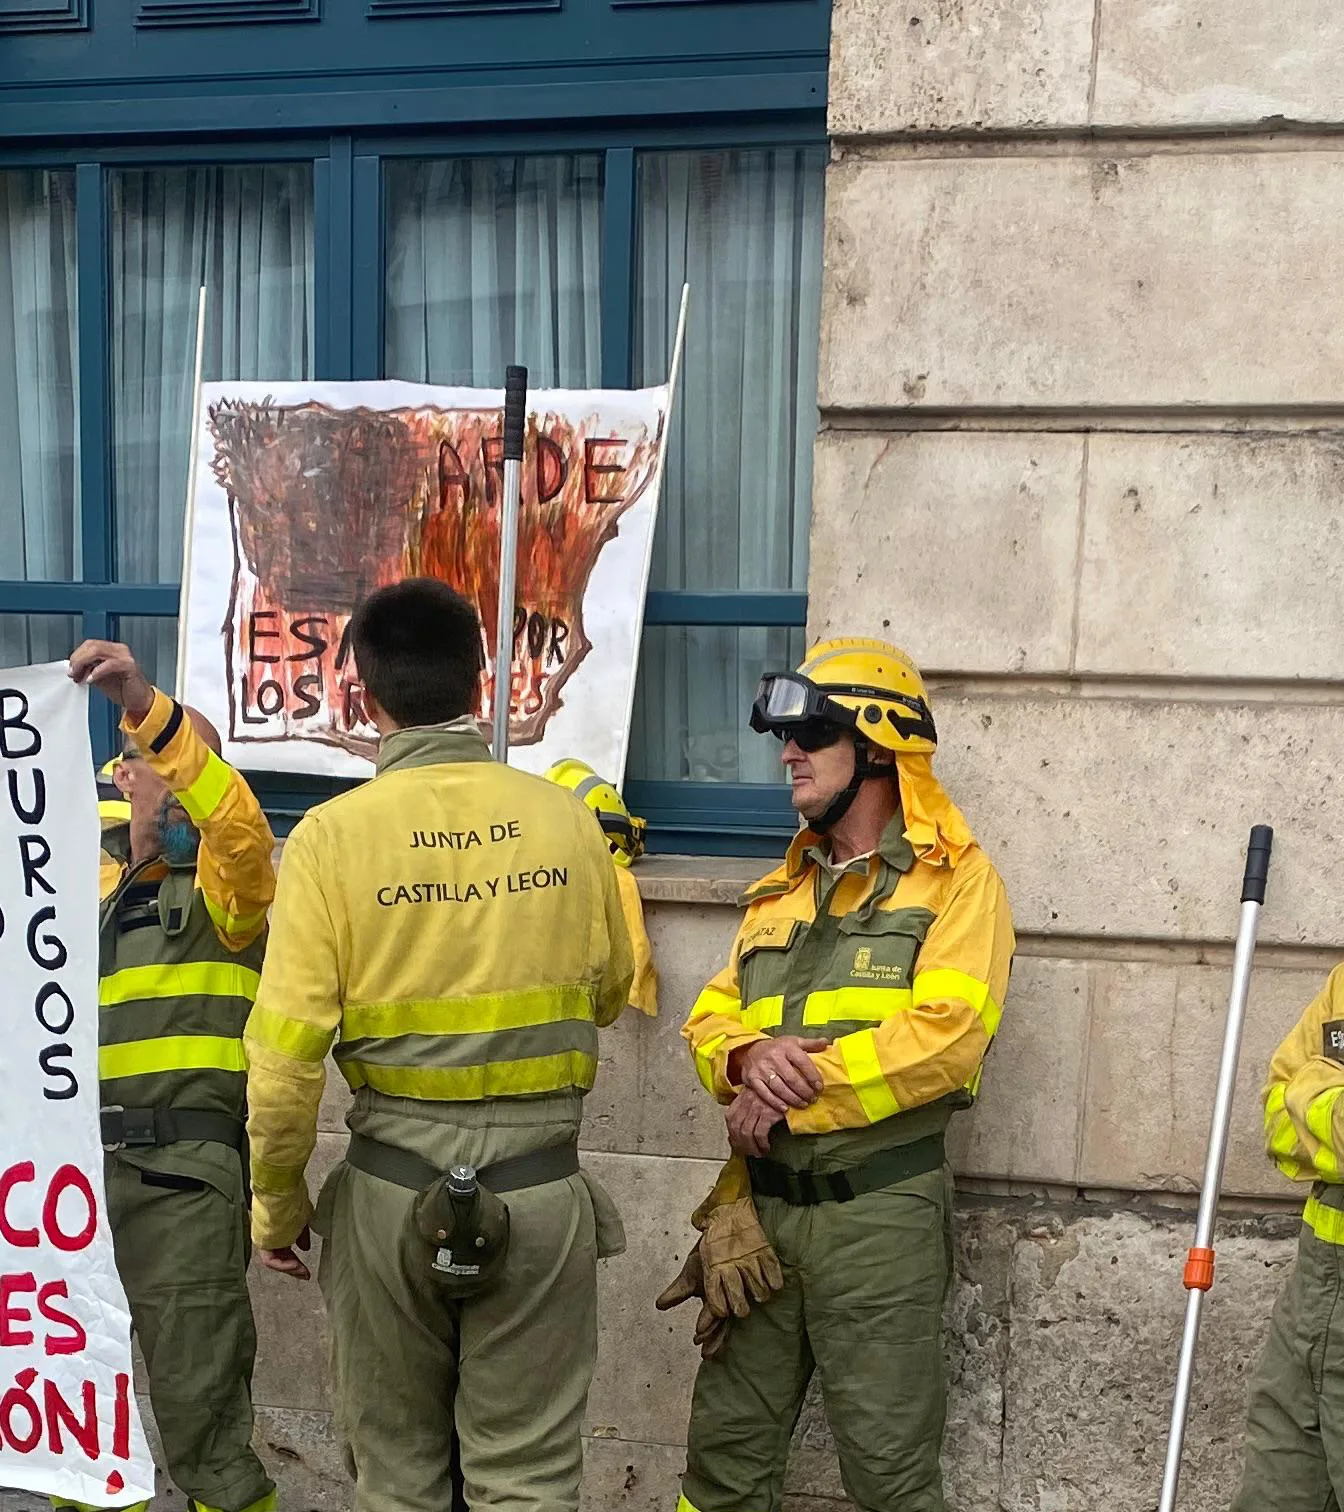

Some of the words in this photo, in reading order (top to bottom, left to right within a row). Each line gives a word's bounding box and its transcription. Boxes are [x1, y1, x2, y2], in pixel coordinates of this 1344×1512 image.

[242, 673, 321, 724] LOS
[409, 831, 482, 849] JUNTA
[490, 820, 521, 842] DE
[377, 883, 482, 906] CASTILLA
[485, 877, 500, 898] Y
[507, 865, 568, 893] LEÓN
